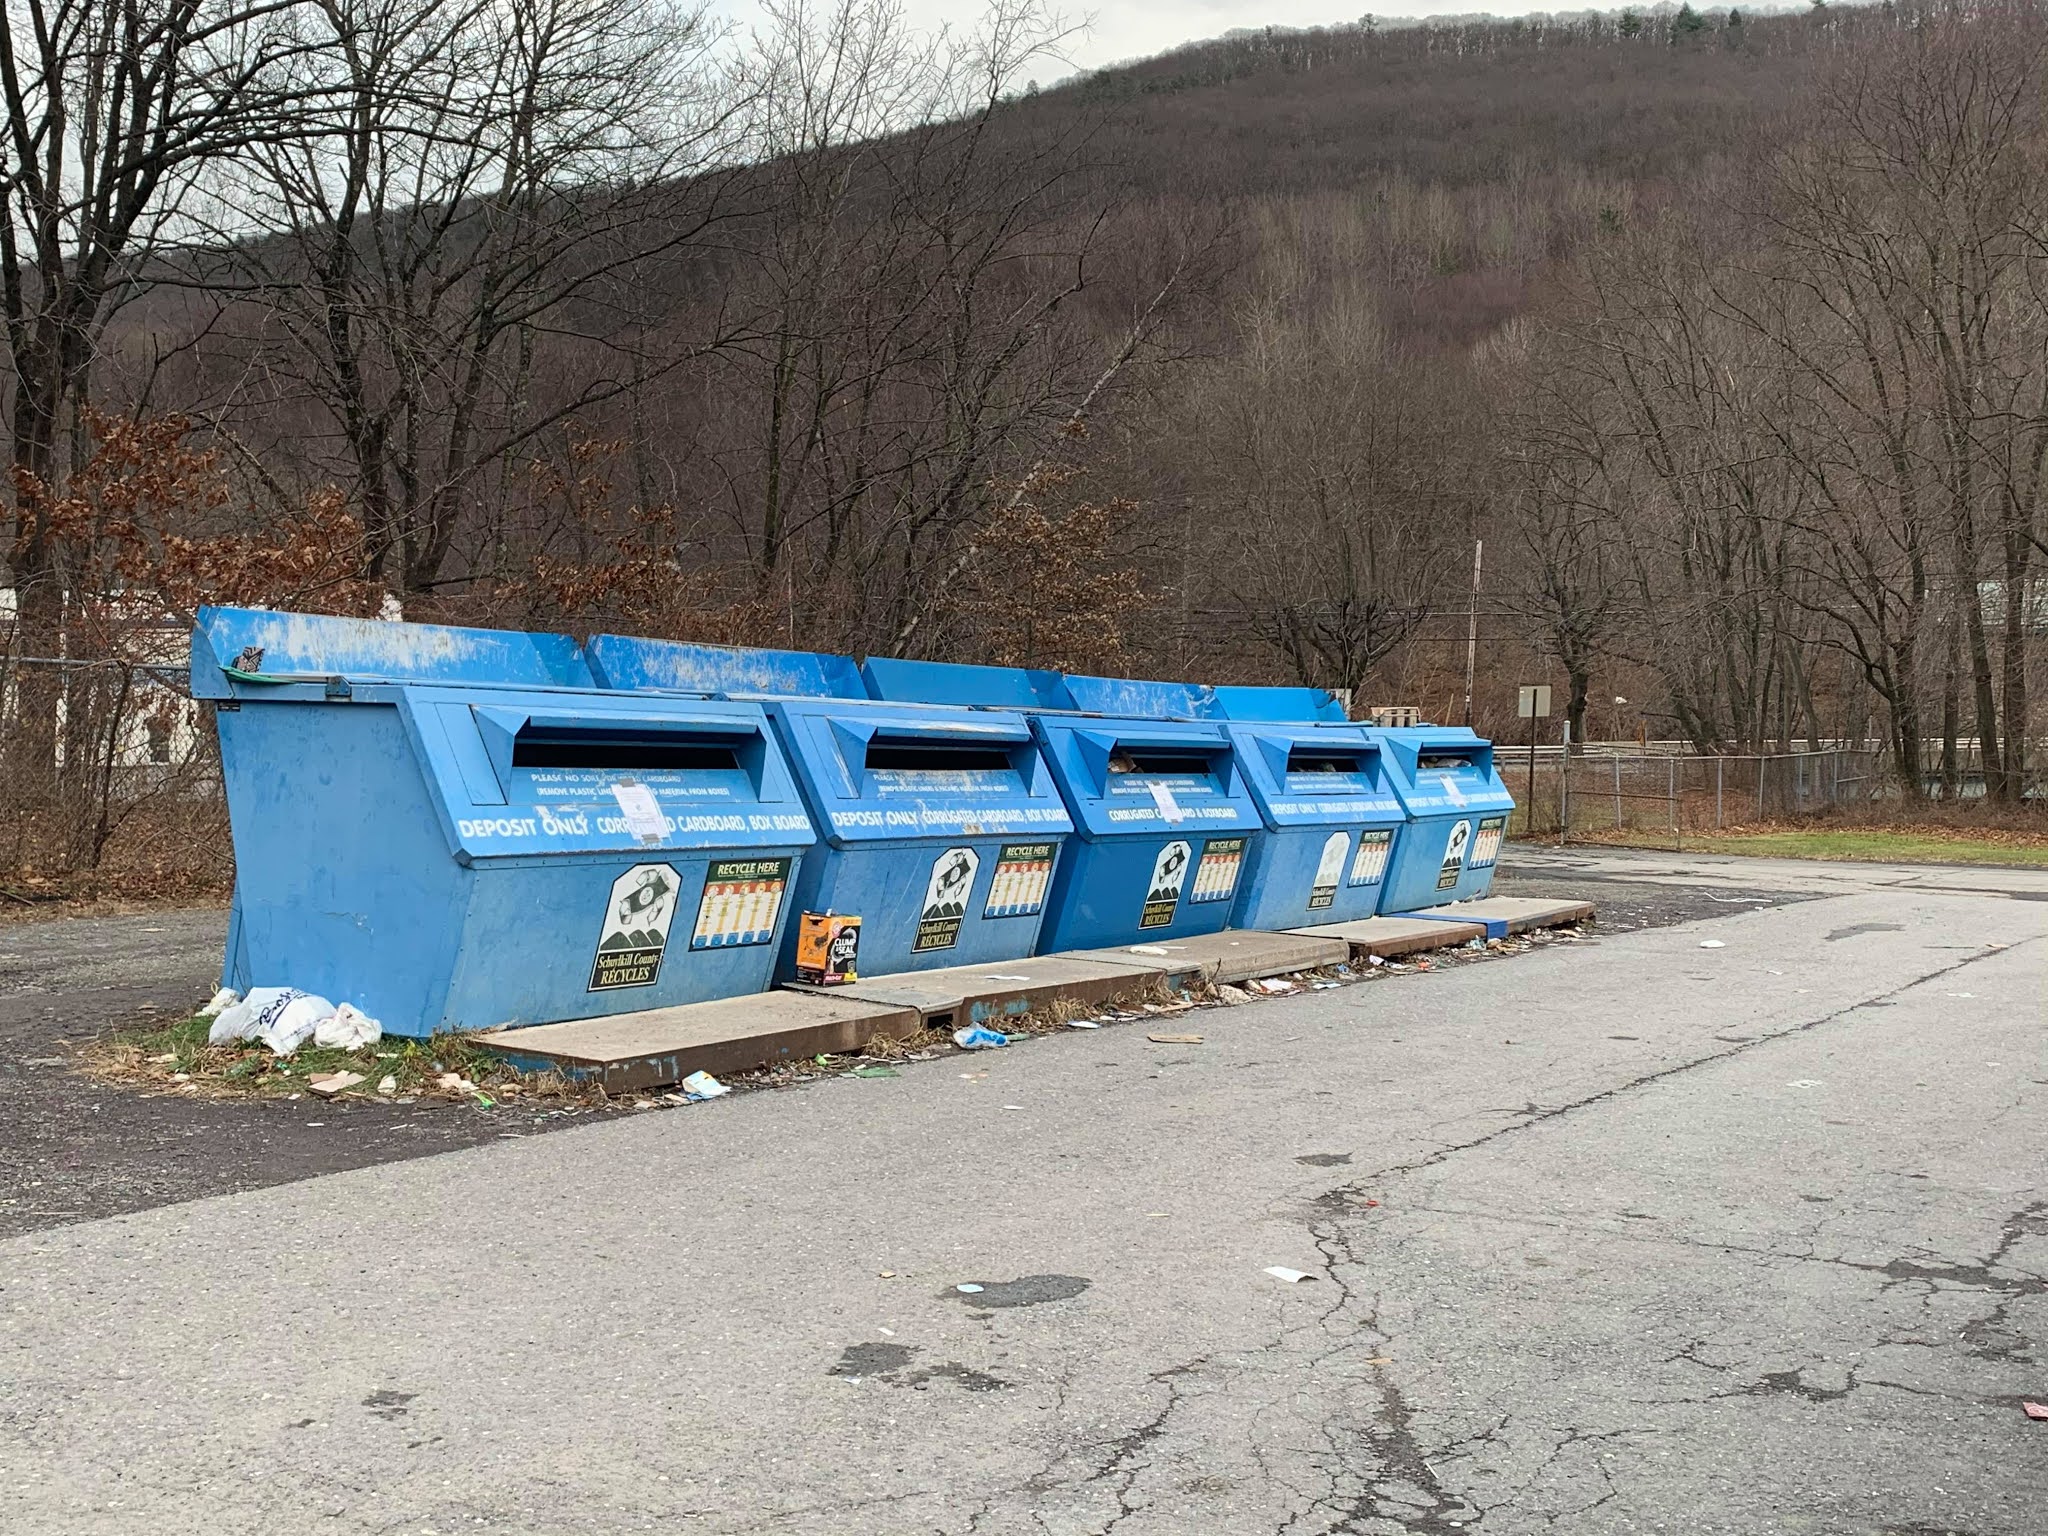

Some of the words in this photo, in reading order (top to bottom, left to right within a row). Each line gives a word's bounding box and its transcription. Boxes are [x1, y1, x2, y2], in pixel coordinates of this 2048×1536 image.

[531, 774, 562, 782] PLEASE
[569, 787, 595, 796] PLASTIC
[659, 787, 687, 796] MATERIAL
[688, 786, 706, 796] FROM
[832, 811, 882, 827] DEPOSIT
[886, 811, 919, 826] ONLY
[922, 809, 977, 825] CORRUGATED
[1025, 808, 1043, 821] BOX
[1043, 808, 1069, 822] BOARD
[1108, 808, 1155, 821] CORRUGATED
[458, 818, 537, 838] DEPOSIT
[542, 817, 588, 837] ONLY
[597, 816, 676, 834] CORRD
[677, 815, 750, 833] CARDBOARD,
[751, 815, 774, 830] BOX
[774, 815, 810, 830] BOARD
[1006, 846, 1033, 857] RECYCLE
[1033, 845, 1050, 855] HERE
[717, 863, 756, 875] RECYCLE
[757, 862, 780, 874] HERE
[943, 921, 959, 934] County
[834, 938, 857, 947] CLUMP
[920, 933, 952, 947] RECYCLES
[838, 945, 855, 954] SEAL
[598, 953, 634, 969] Schuylkill
[634, 952, 660, 967] County
[600, 967, 650, 985] RECYCLES
